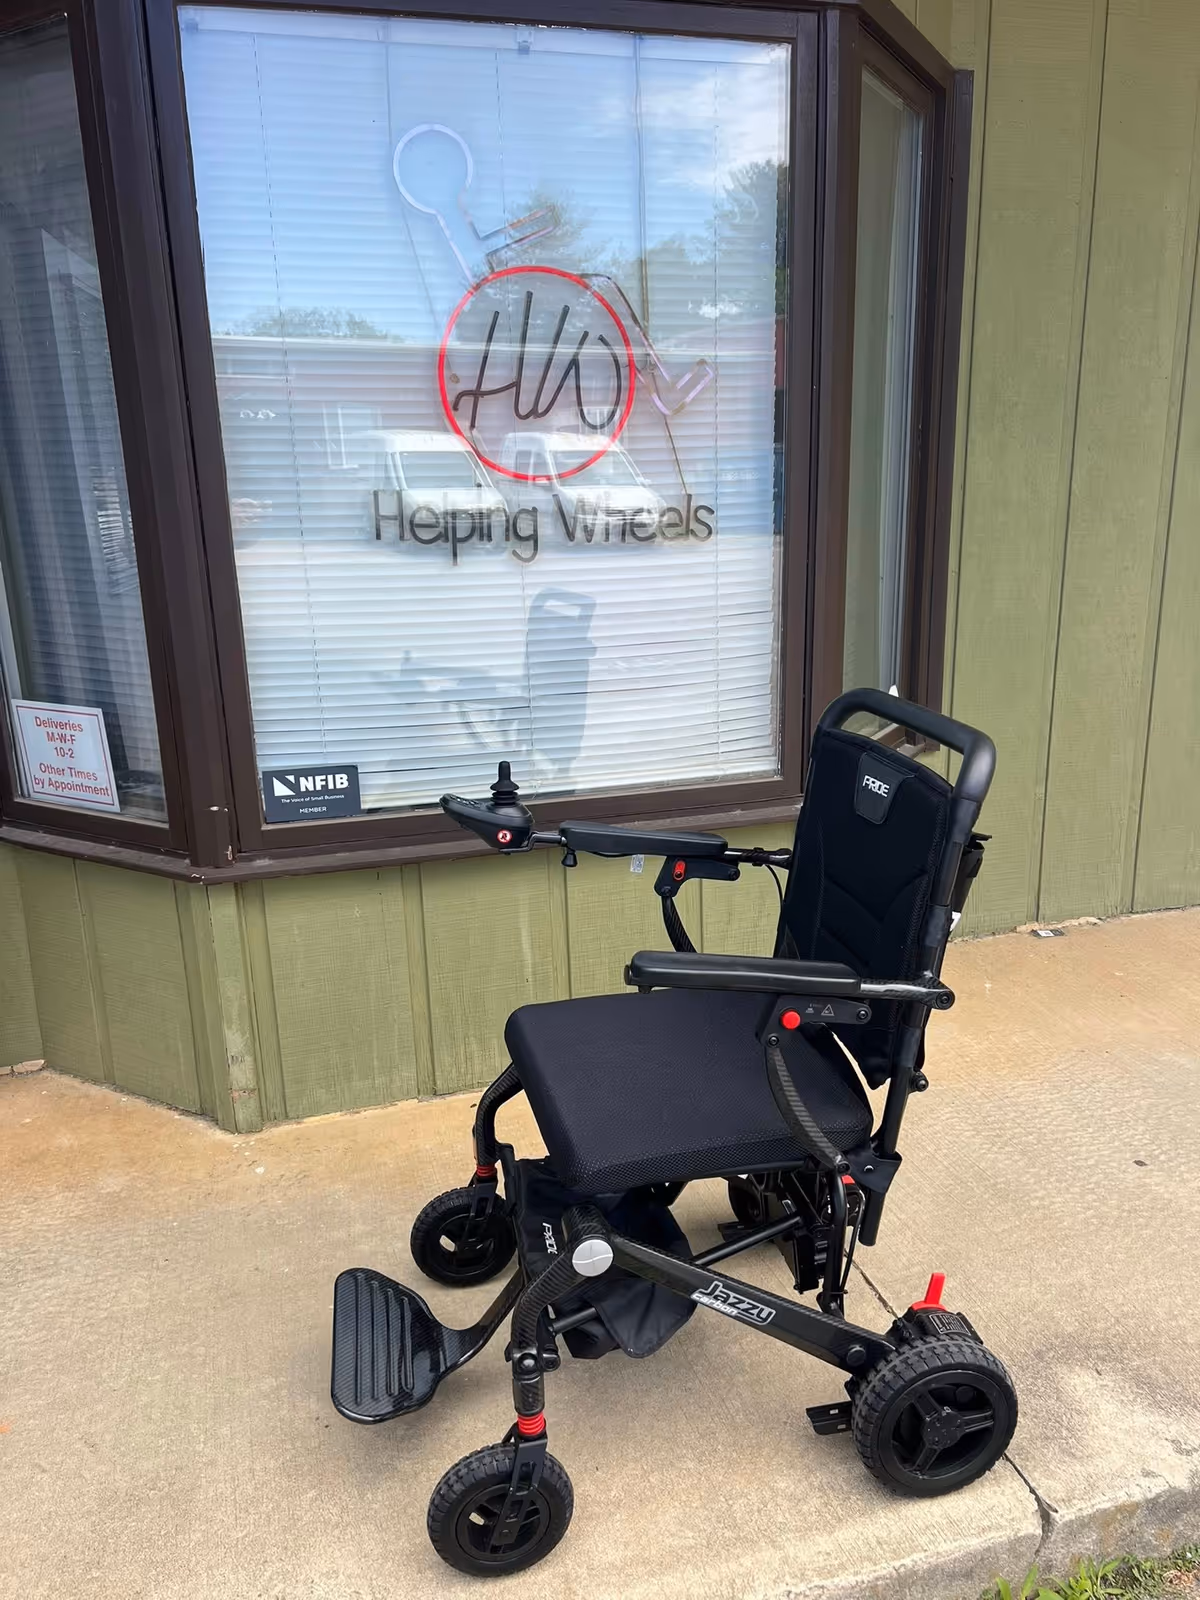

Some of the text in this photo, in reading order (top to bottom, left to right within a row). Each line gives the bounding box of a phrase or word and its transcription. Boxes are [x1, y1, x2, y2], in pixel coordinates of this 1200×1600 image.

[373, 482, 715, 566] Helping Wheels
[34, 716, 84, 733] Deliveries
[46, 731, 76, 745] M-W-F
[54, 746, 75, 759] 10-2
[39, 762, 98, 781] Other Times
[33, 774, 110, 796] by Appointment
[299, 773, 349, 792] NFIB
[862, 774, 890, 798] PRIDE
[299, 806, 327, 814] MEMBER
[691, 1292, 739, 1316] carbon
[698, 1281, 776, 1325] Jazzy
